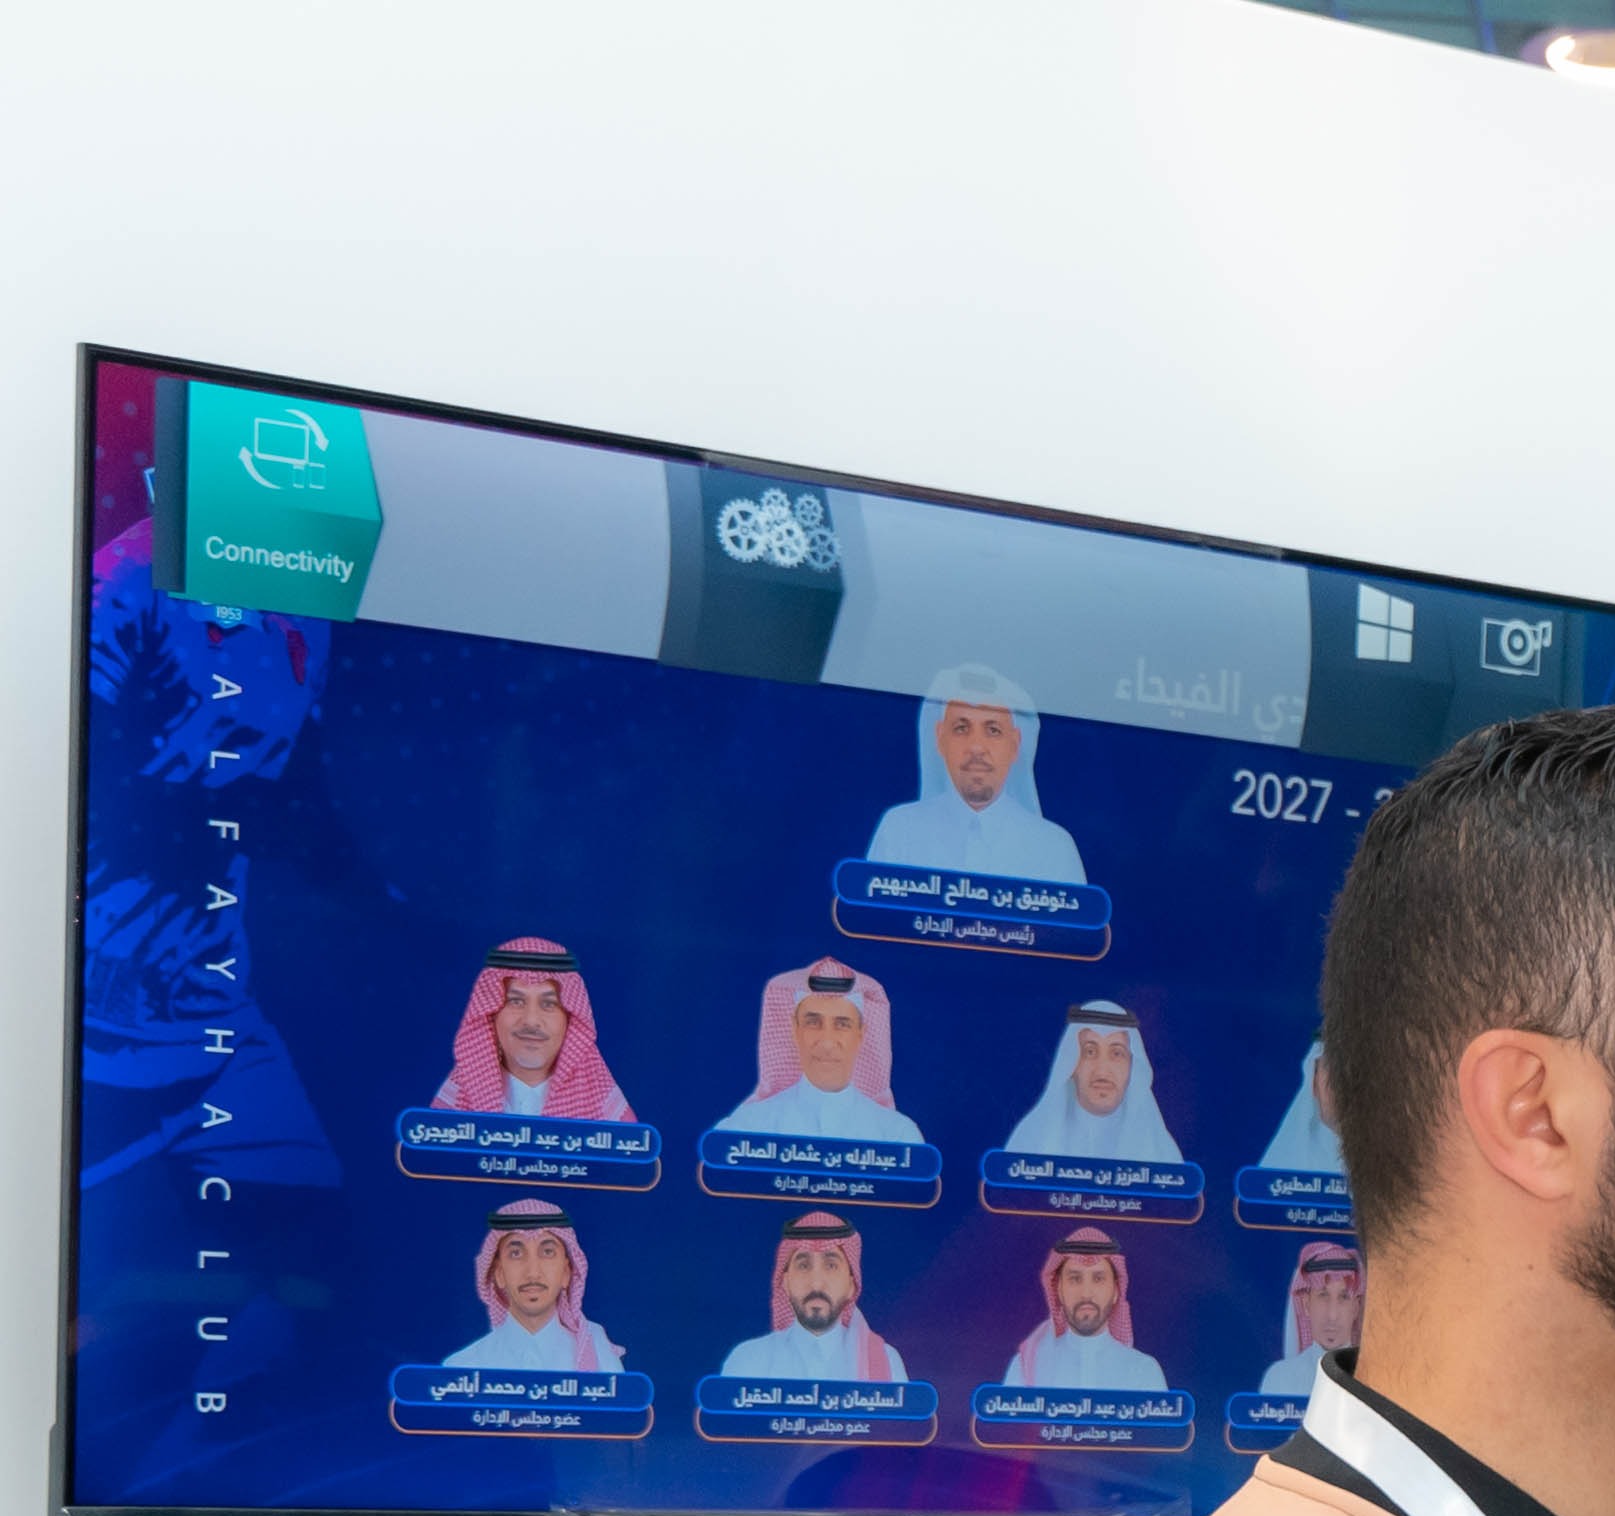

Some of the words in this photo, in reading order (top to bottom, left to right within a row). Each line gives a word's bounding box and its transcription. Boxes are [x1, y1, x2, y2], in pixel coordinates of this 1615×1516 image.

[205, 535, 355, 583] Connectivity
[1231, 769, 1333, 824] 2027
[945, 877, 989, 906] صالح
[992, 888, 1013, 908] بن
[479, 1127, 531, 1148] الرحمن
[563, 1136, 582, 1152] بن
[780, 1144, 821, 1164] عثمان
[823, 1150, 843, 1168] بن
[1056, 1167, 1093, 1181] محمد
[1095, 1170, 1112, 1186] بن
[1269, 1176, 1322, 1197] المطيري
[483, 1380, 526, 1395] محمد
[529, 1384, 548, 1400] بن
[785, 1383, 819, 1405] أحمد
[821, 1393, 841, 1410] بن
[1047, 1398, 1092, 1418] الرحمن
[1116, 1405, 1134, 1420] بن
